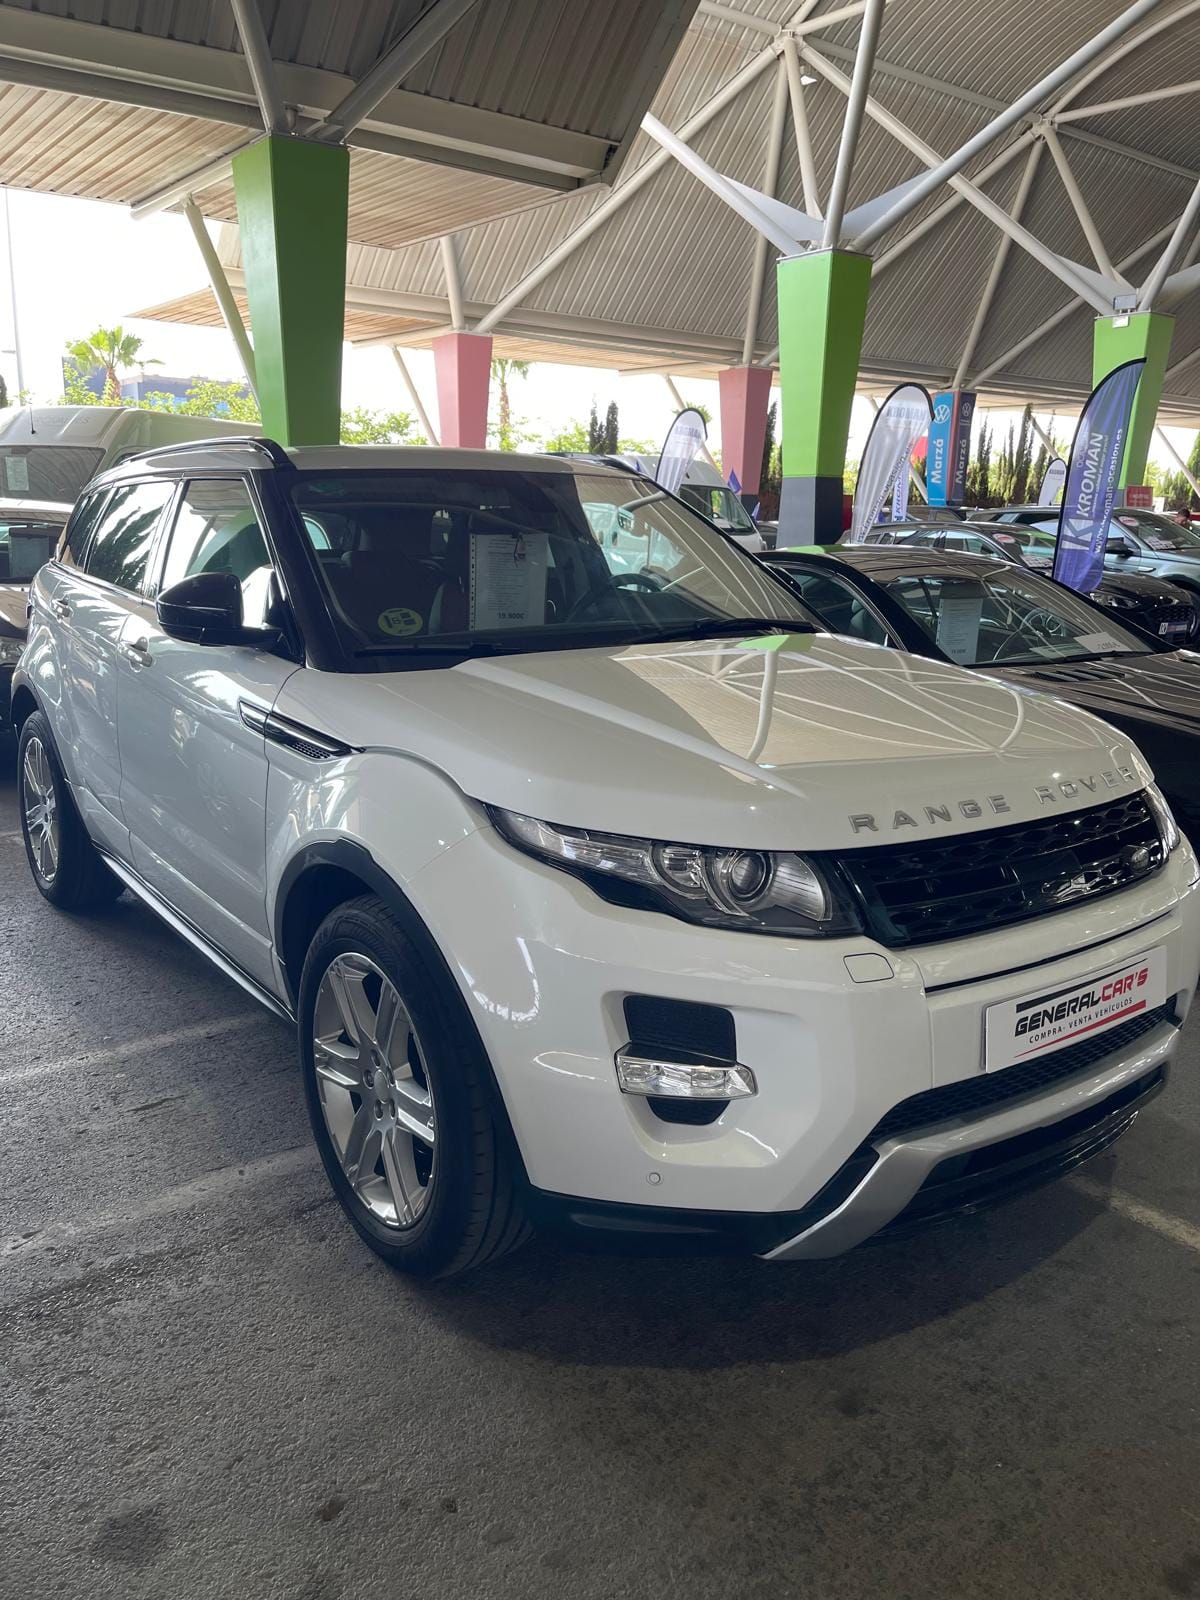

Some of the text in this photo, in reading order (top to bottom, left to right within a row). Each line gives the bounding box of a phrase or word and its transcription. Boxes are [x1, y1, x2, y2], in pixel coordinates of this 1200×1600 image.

[931, 438, 944, 484] Marzá
[955, 439, 967, 484] Marzá
[1075, 432, 1104, 517] KROMAN
[847, 765, 1136, 834] RANGE ROVER
[1014, 967, 1149, 1038] GENERALCAR'S
[1068, 1014, 1093, 1030] VENTA
[1095, 996, 1134, 1019] VEHÍCULOS
